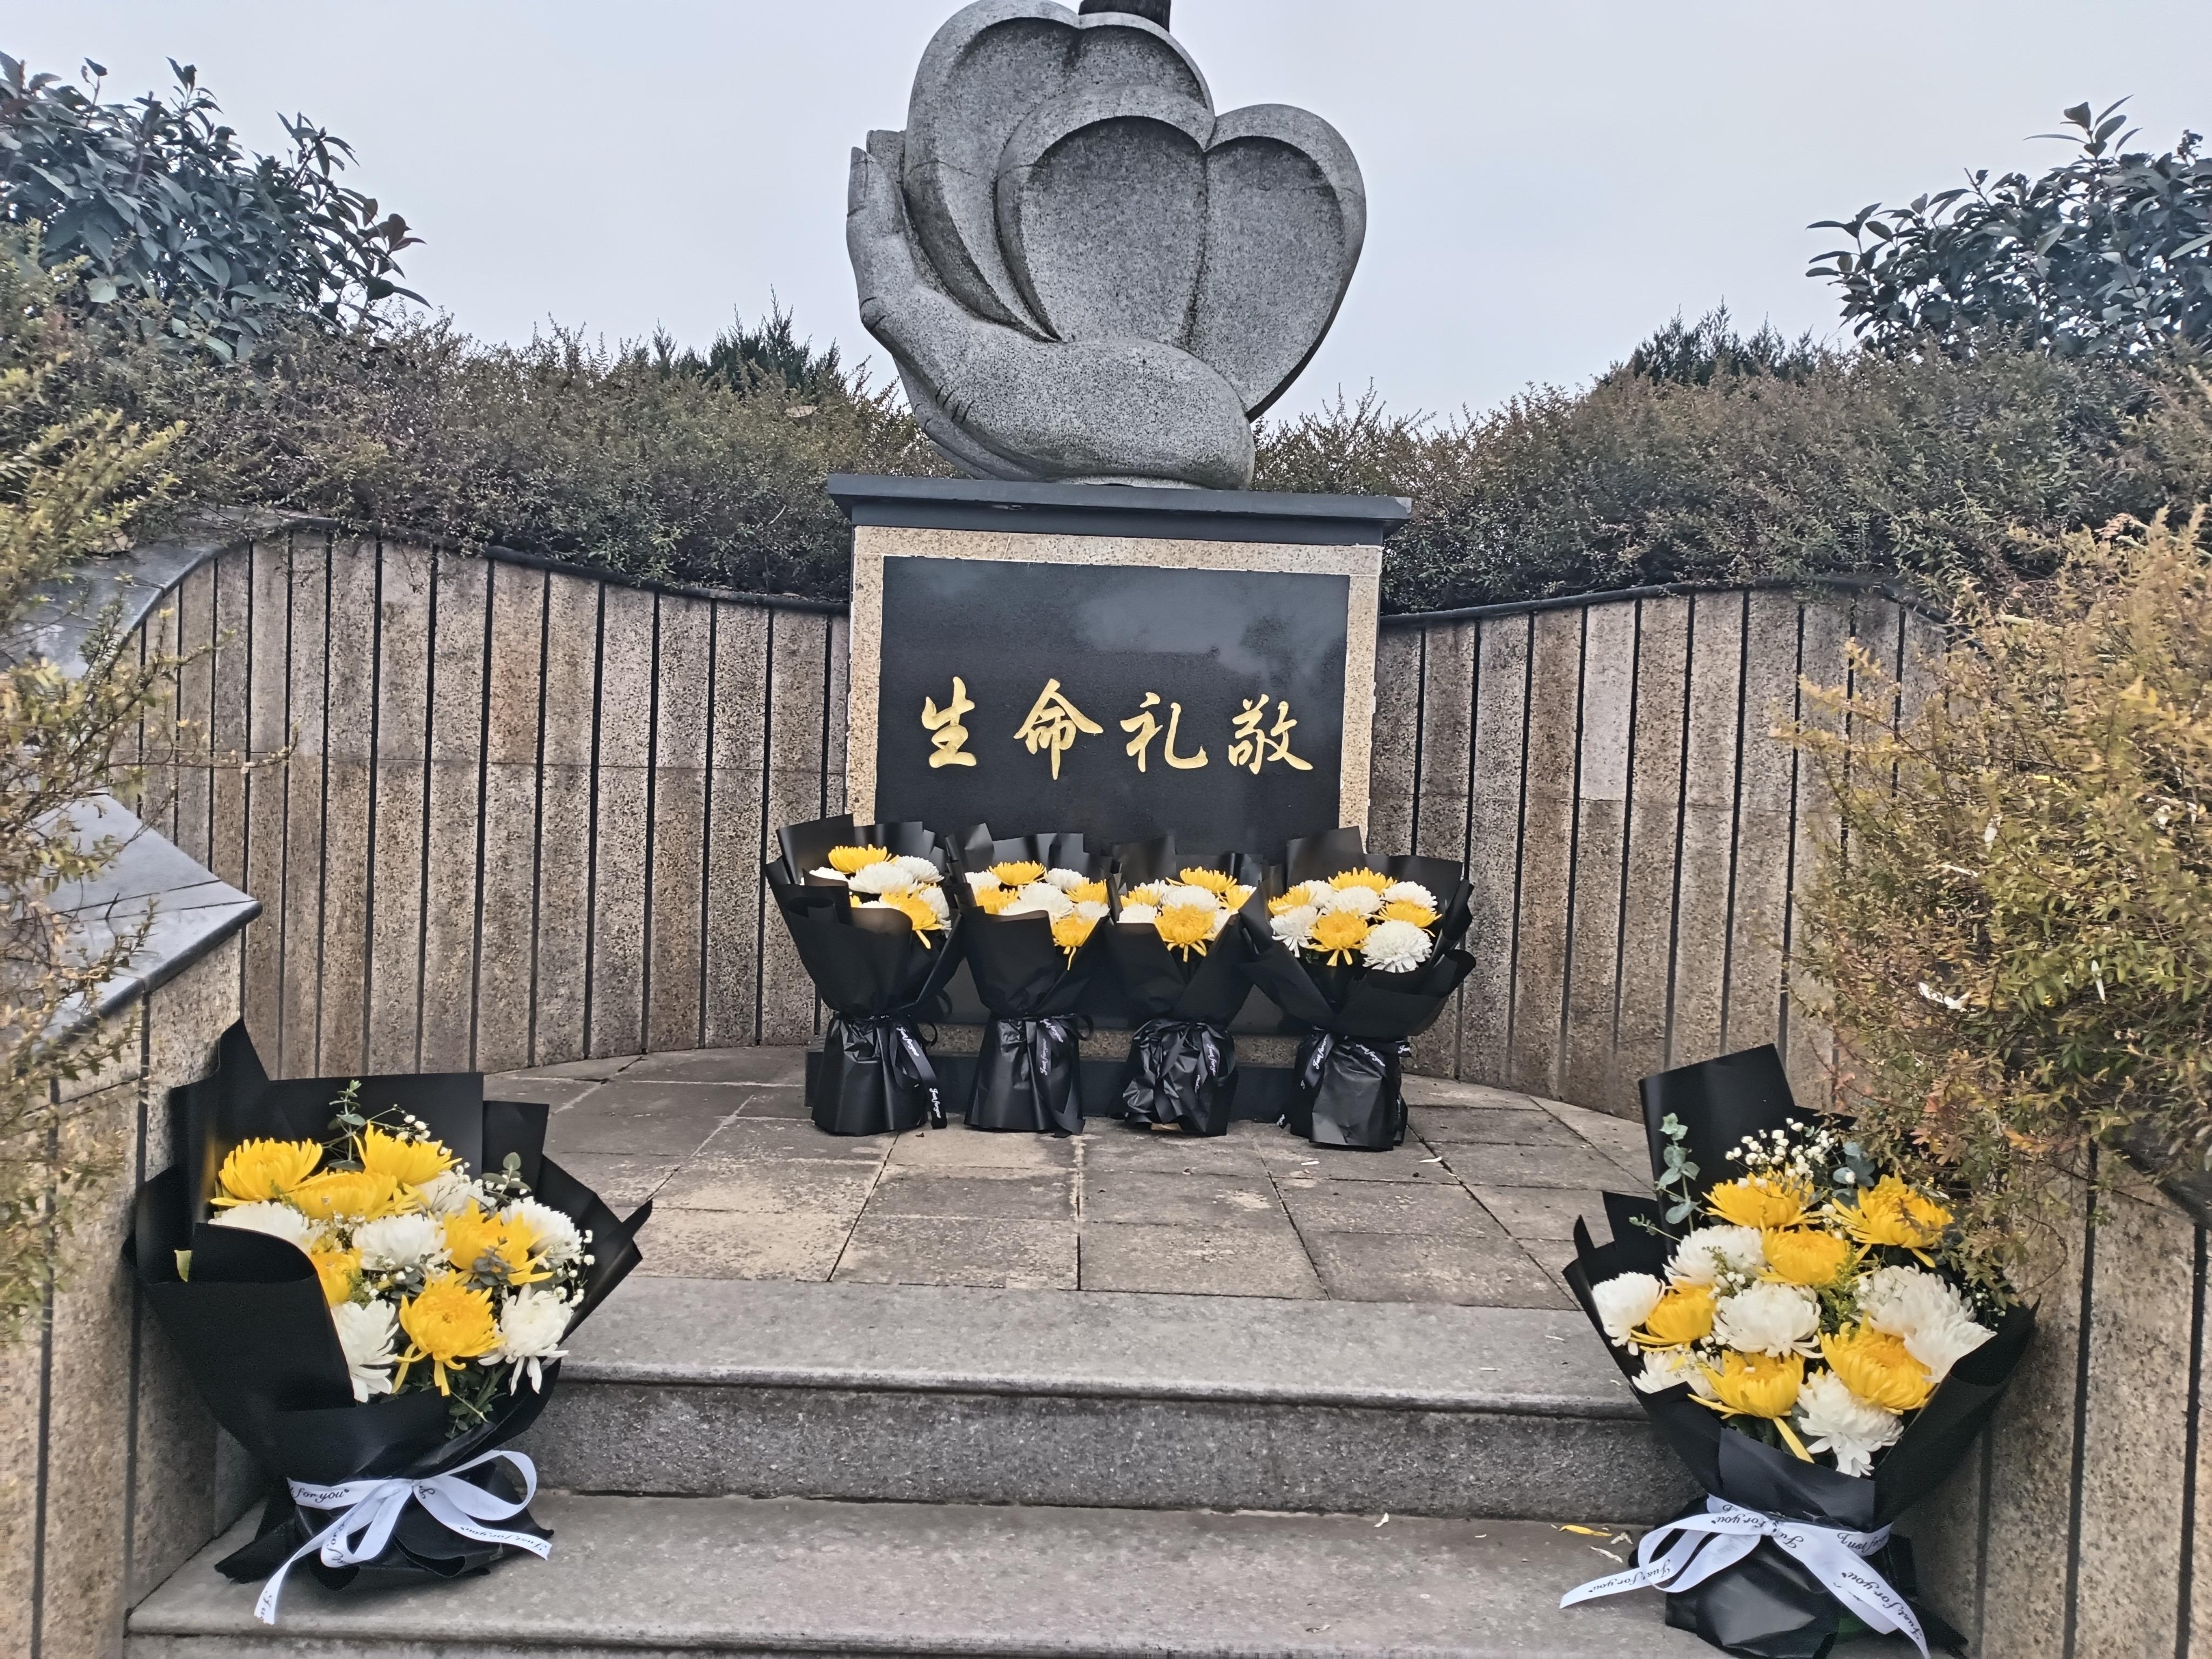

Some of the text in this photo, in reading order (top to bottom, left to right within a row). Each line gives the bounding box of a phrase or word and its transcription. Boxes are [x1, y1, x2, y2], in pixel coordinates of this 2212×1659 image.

[921, 676, 1313, 780] 生命礼敬
[293, 1487, 318, 1499] for
[314, 1491, 345, 1503] you
[1716, 1513, 1746, 1523] you
[1846, 1572, 1880, 1590] you
